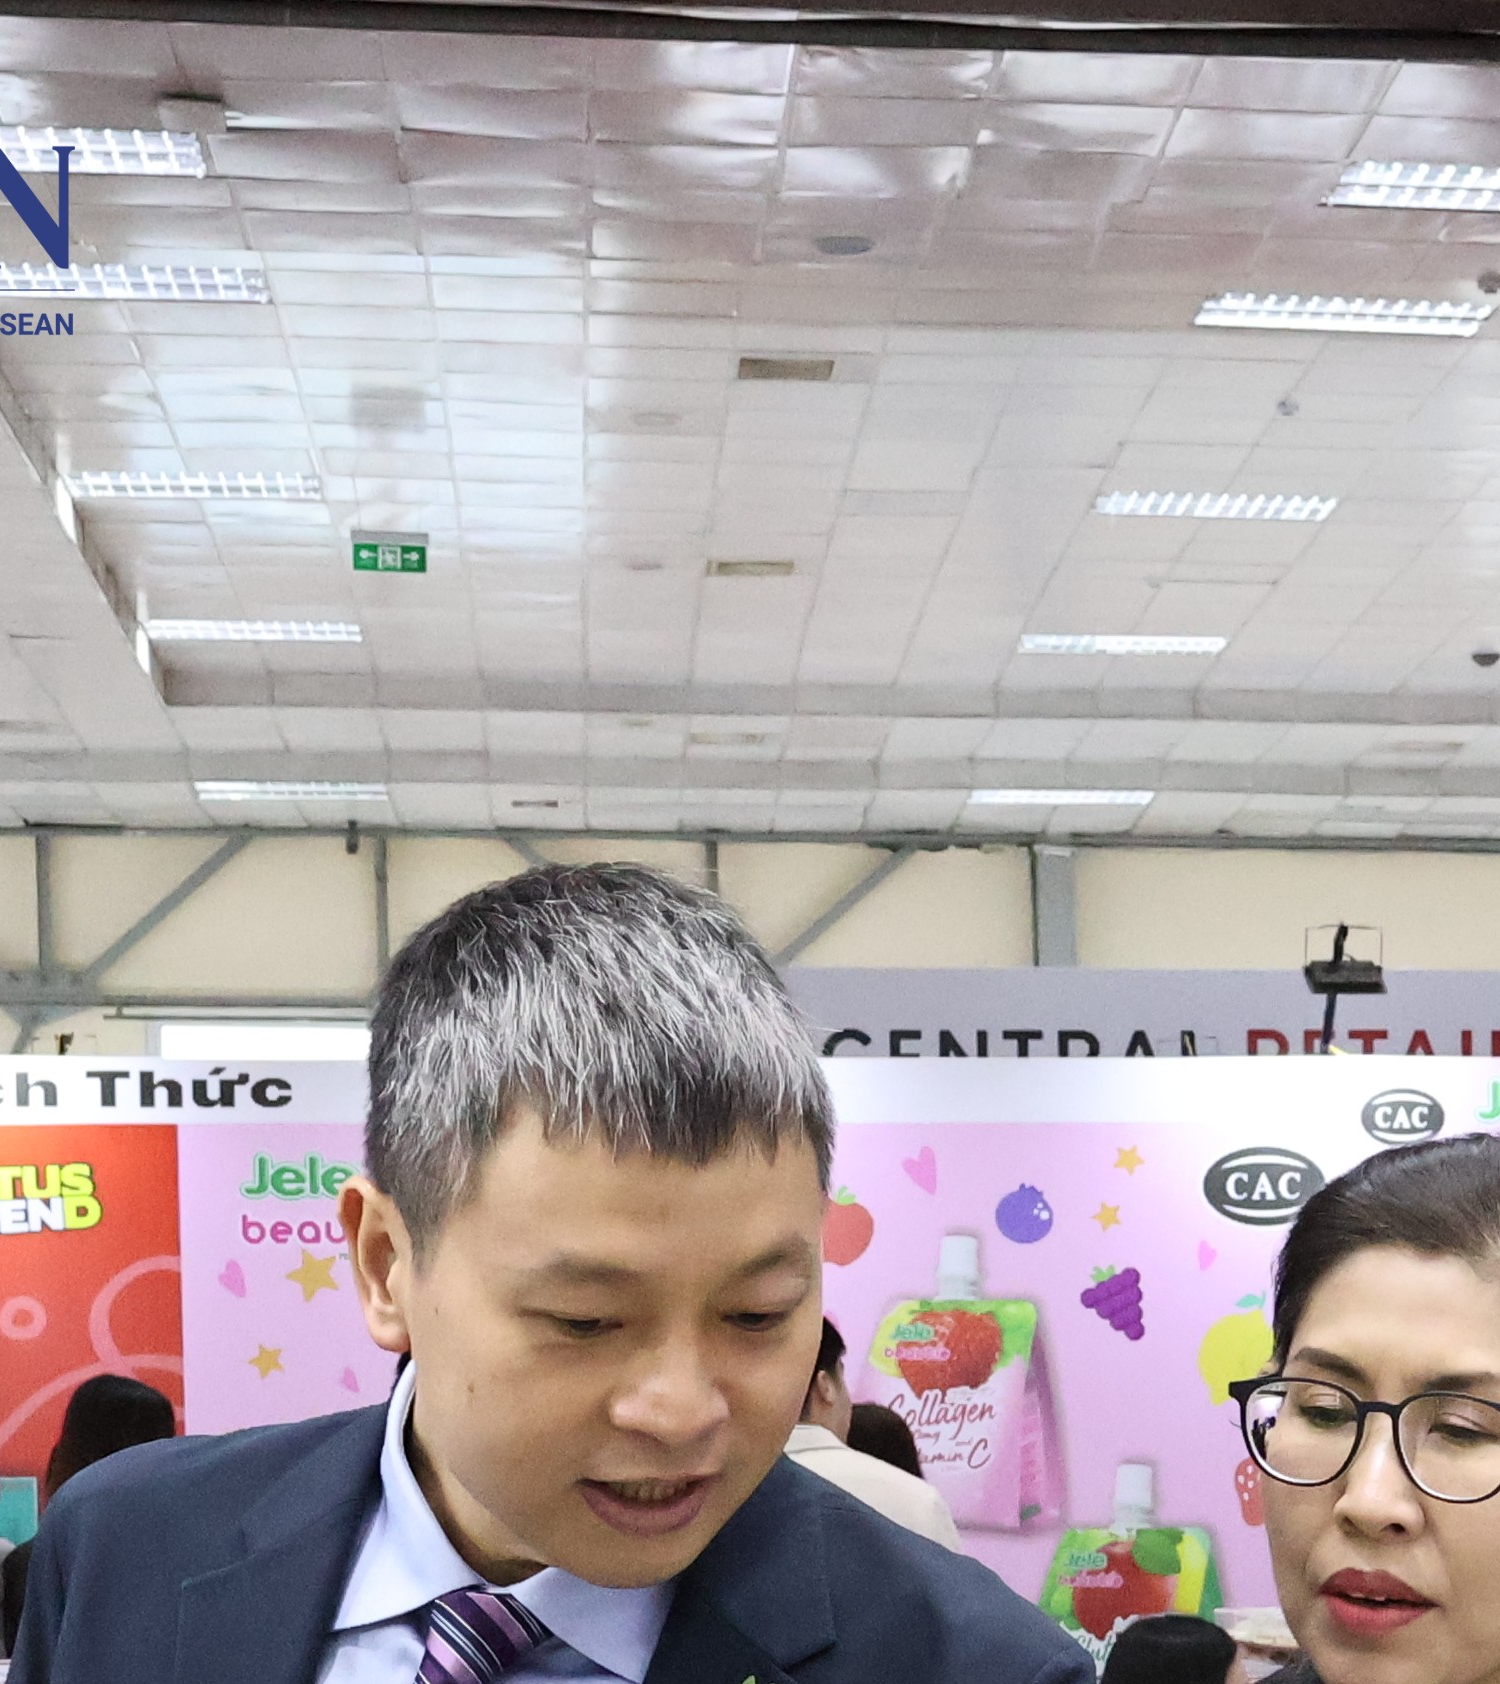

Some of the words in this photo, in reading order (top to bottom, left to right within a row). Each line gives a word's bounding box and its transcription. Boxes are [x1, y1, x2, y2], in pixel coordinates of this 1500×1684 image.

[98, 1066, 292, 1109] Thức
[1372, 1105, 1429, 1130] CAC
[241, 1152, 359, 1200] Jele
[1225, 1171, 1300, 1201] CAC
[241, 1215, 345, 1245] beau
